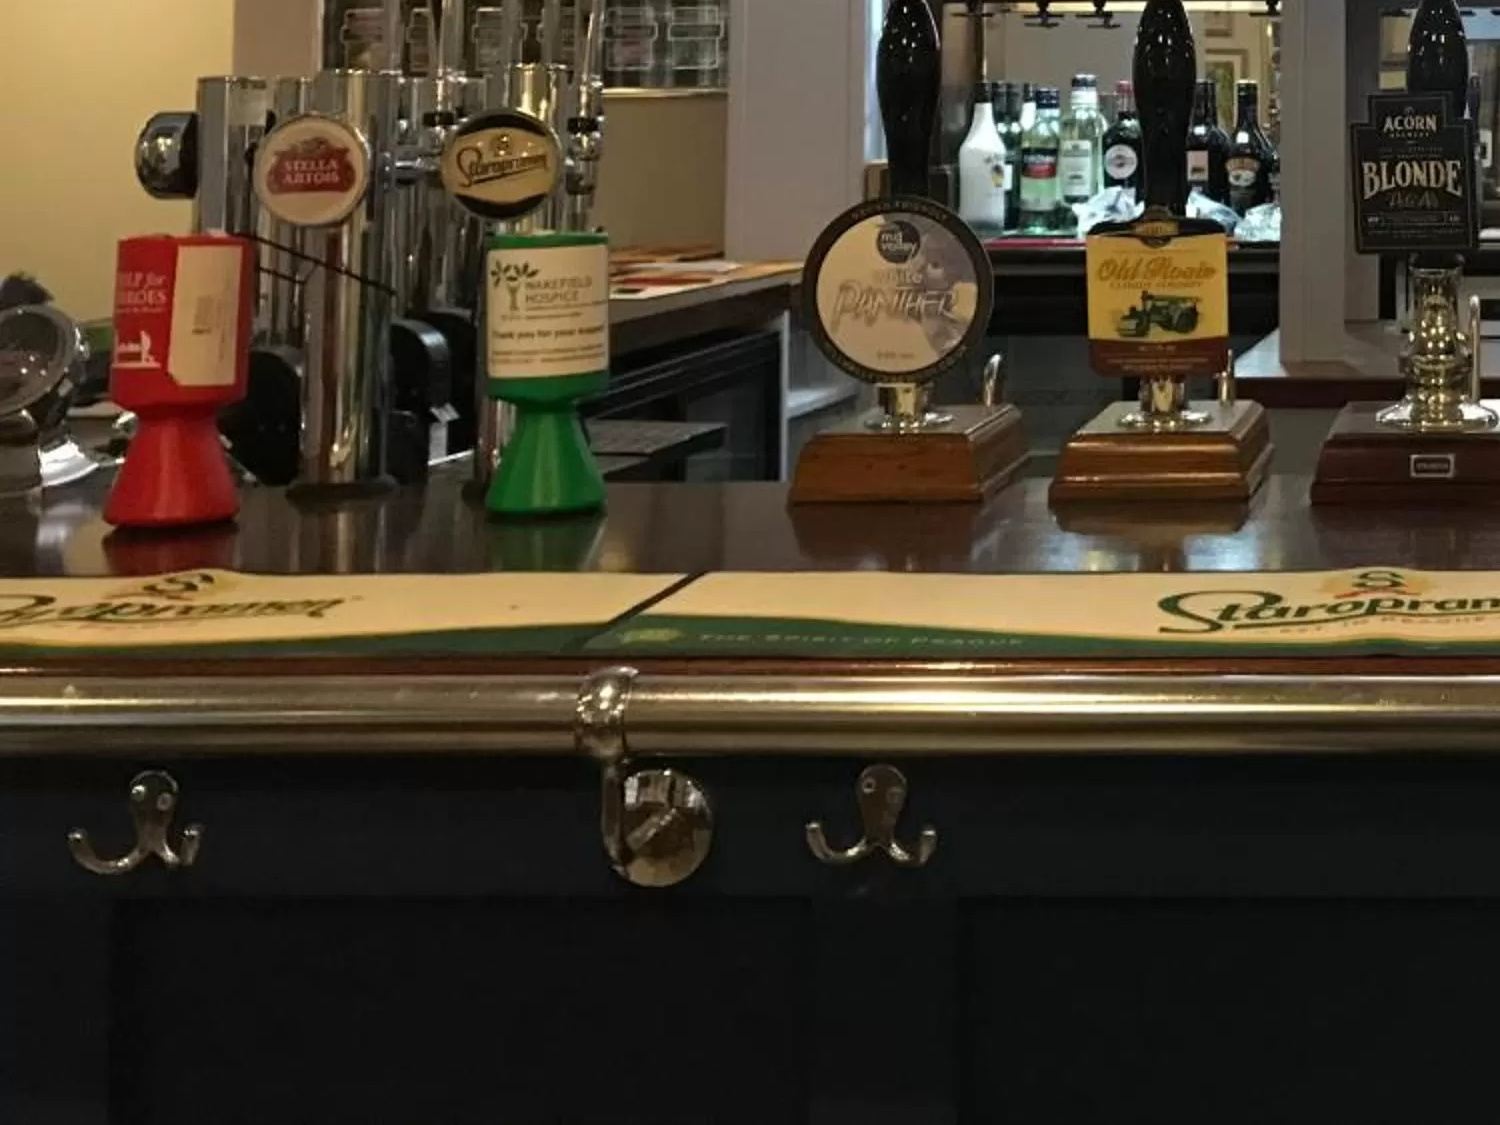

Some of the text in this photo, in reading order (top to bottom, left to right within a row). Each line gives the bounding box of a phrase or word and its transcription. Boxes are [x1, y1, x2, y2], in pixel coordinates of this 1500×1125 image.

[1383, 113, 1438, 133] ACORN
[283, 158, 338, 172] STELLA
[281, 171, 340, 184] ARTOIS
[1361, 159, 1464, 201] BLONDE
[1098, 256, 1143, 281] Old
